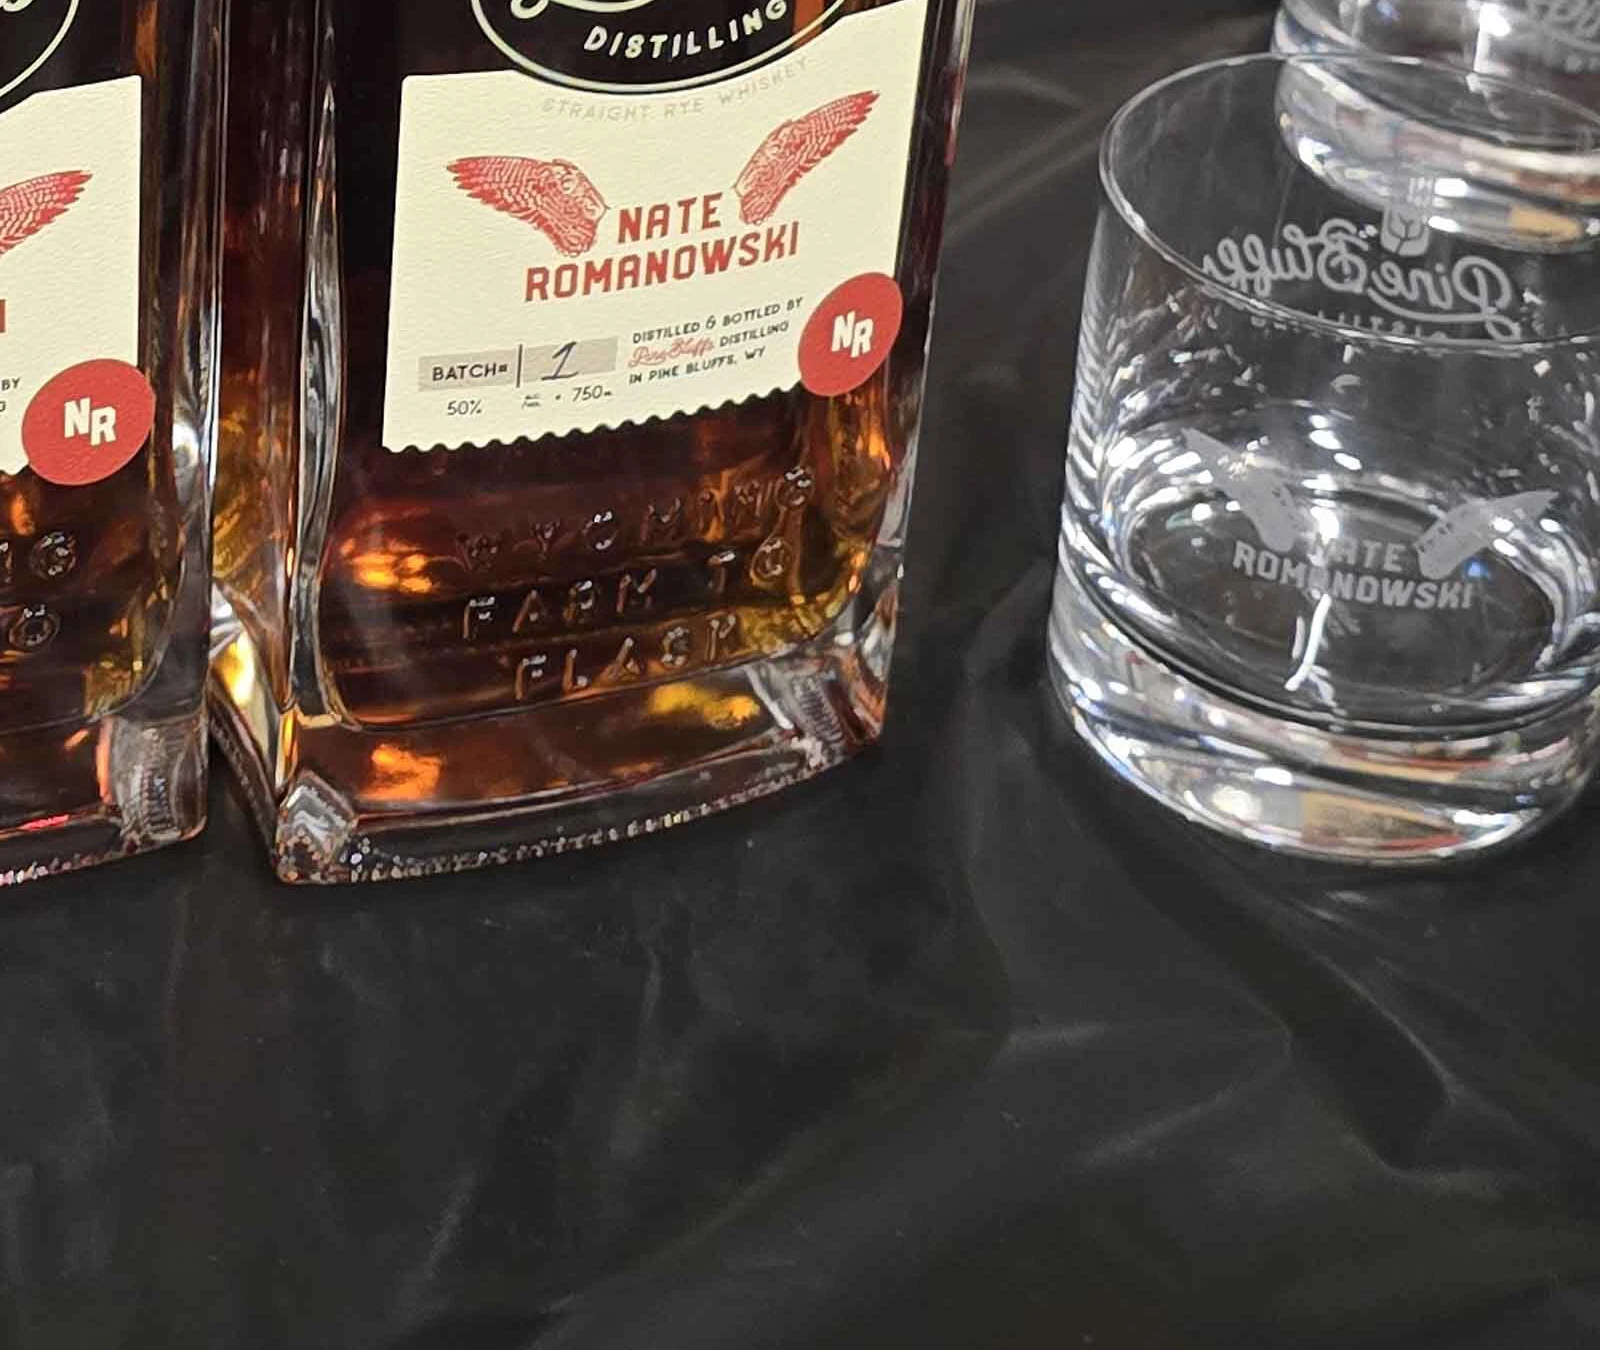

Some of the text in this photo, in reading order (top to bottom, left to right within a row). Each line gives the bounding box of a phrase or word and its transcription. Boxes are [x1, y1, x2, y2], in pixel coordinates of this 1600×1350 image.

[542, 57, 808, 121] STRAIGHT RYE WHISKEY
[618, 191, 724, 243] NATE
[524, 221, 800, 302] ROMANOWSKI
[633, 297, 803, 344] DISTILLED & BOTTLED BY
[719, 320, 789, 347] DISTILLING
[832, 311, 875, 359] NR
[540, 341, 579, 381] 1
[629, 346, 766, 385] IN PINE BLUFFS, WY
[1, 377, 21, 392] BY
[64, 397, 116, 446] NR
[447, 399, 482, 416] 50%
[1312, 537, 1407, 573] ATE
